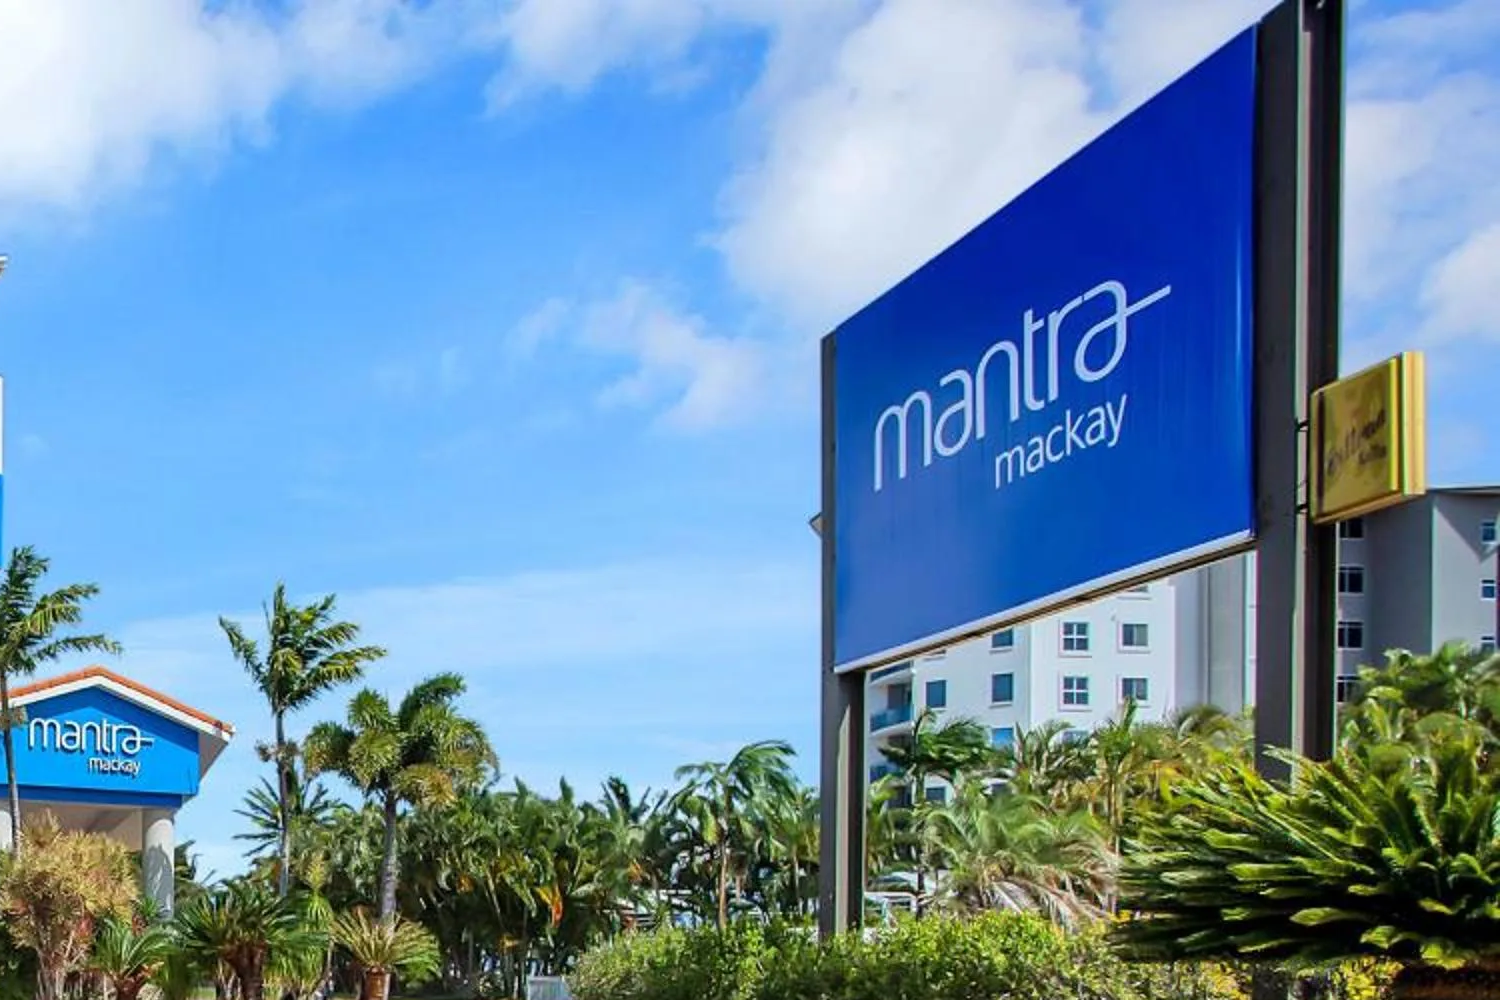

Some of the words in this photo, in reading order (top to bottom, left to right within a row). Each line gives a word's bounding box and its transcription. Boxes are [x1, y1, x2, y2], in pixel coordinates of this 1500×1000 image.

[874, 280, 1172, 492] mantra
[995, 393, 1128, 489] mackay
[28, 717, 156, 756] mantra
[88, 756, 141, 777] mackay
